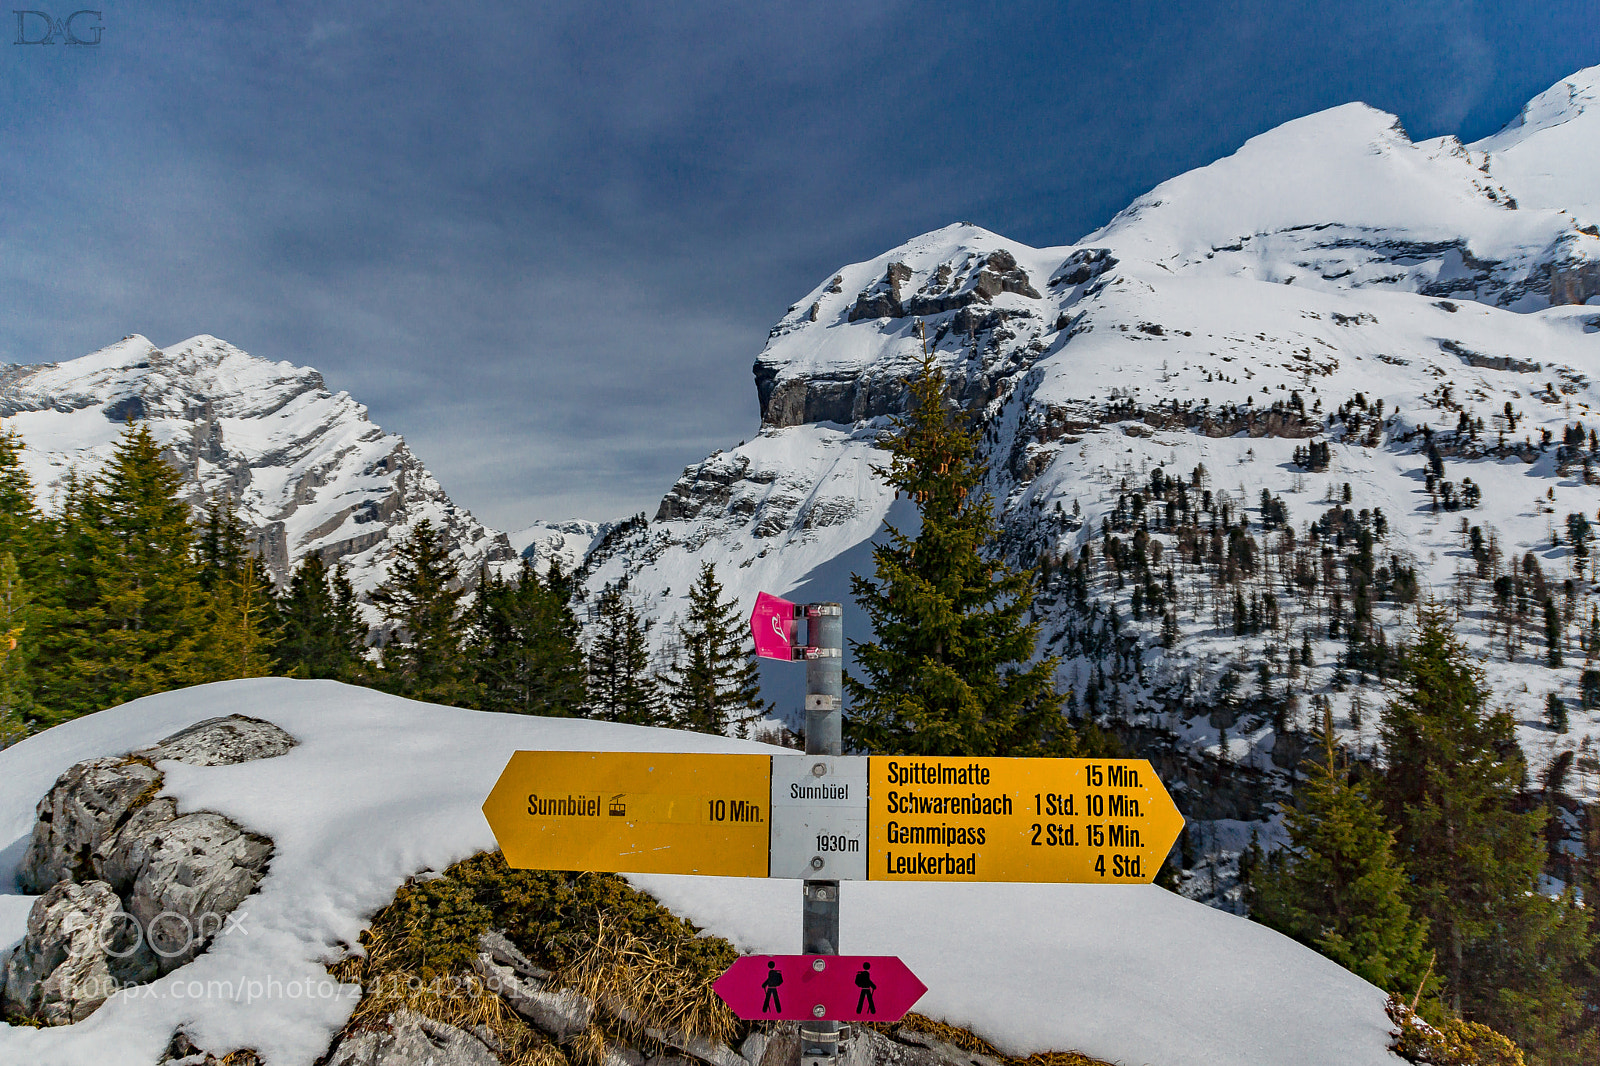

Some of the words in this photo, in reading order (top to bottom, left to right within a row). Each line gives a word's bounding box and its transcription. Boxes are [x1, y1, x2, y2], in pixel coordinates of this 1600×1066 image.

[887, 761, 990, 787] Spittelmatte
[1085, 765, 1103, 787] 15
[1108, 765, 1143, 788] Min.
[789, 783, 849, 800] Sunnbüel
[887, 791, 1013, 815] Schwarenbach
[1034, 793, 1041, 816] 1
[1046, 793, 1079, 817] Std.
[1085, 794, 1104, 817] 10
[1108, 794, 1145, 817] Min.
[527, 794, 601, 817] Sunnbüel
[708, 800, 725, 822] 10
[729, 800, 764, 823] Min.
[816, 834, 859, 852] 1930m
[887, 821, 986, 847] Gemmipass
[1031, 823, 1042, 846] 2
[1046, 823, 1079, 847] Std.
[1085, 824, 1104, 847] 15
[1108, 824, 1145, 848] Min.
[887, 851, 976, 875] Leukerbad
[1094, 854, 1106, 877] 4
[1112, 854, 1146, 878] Std.
